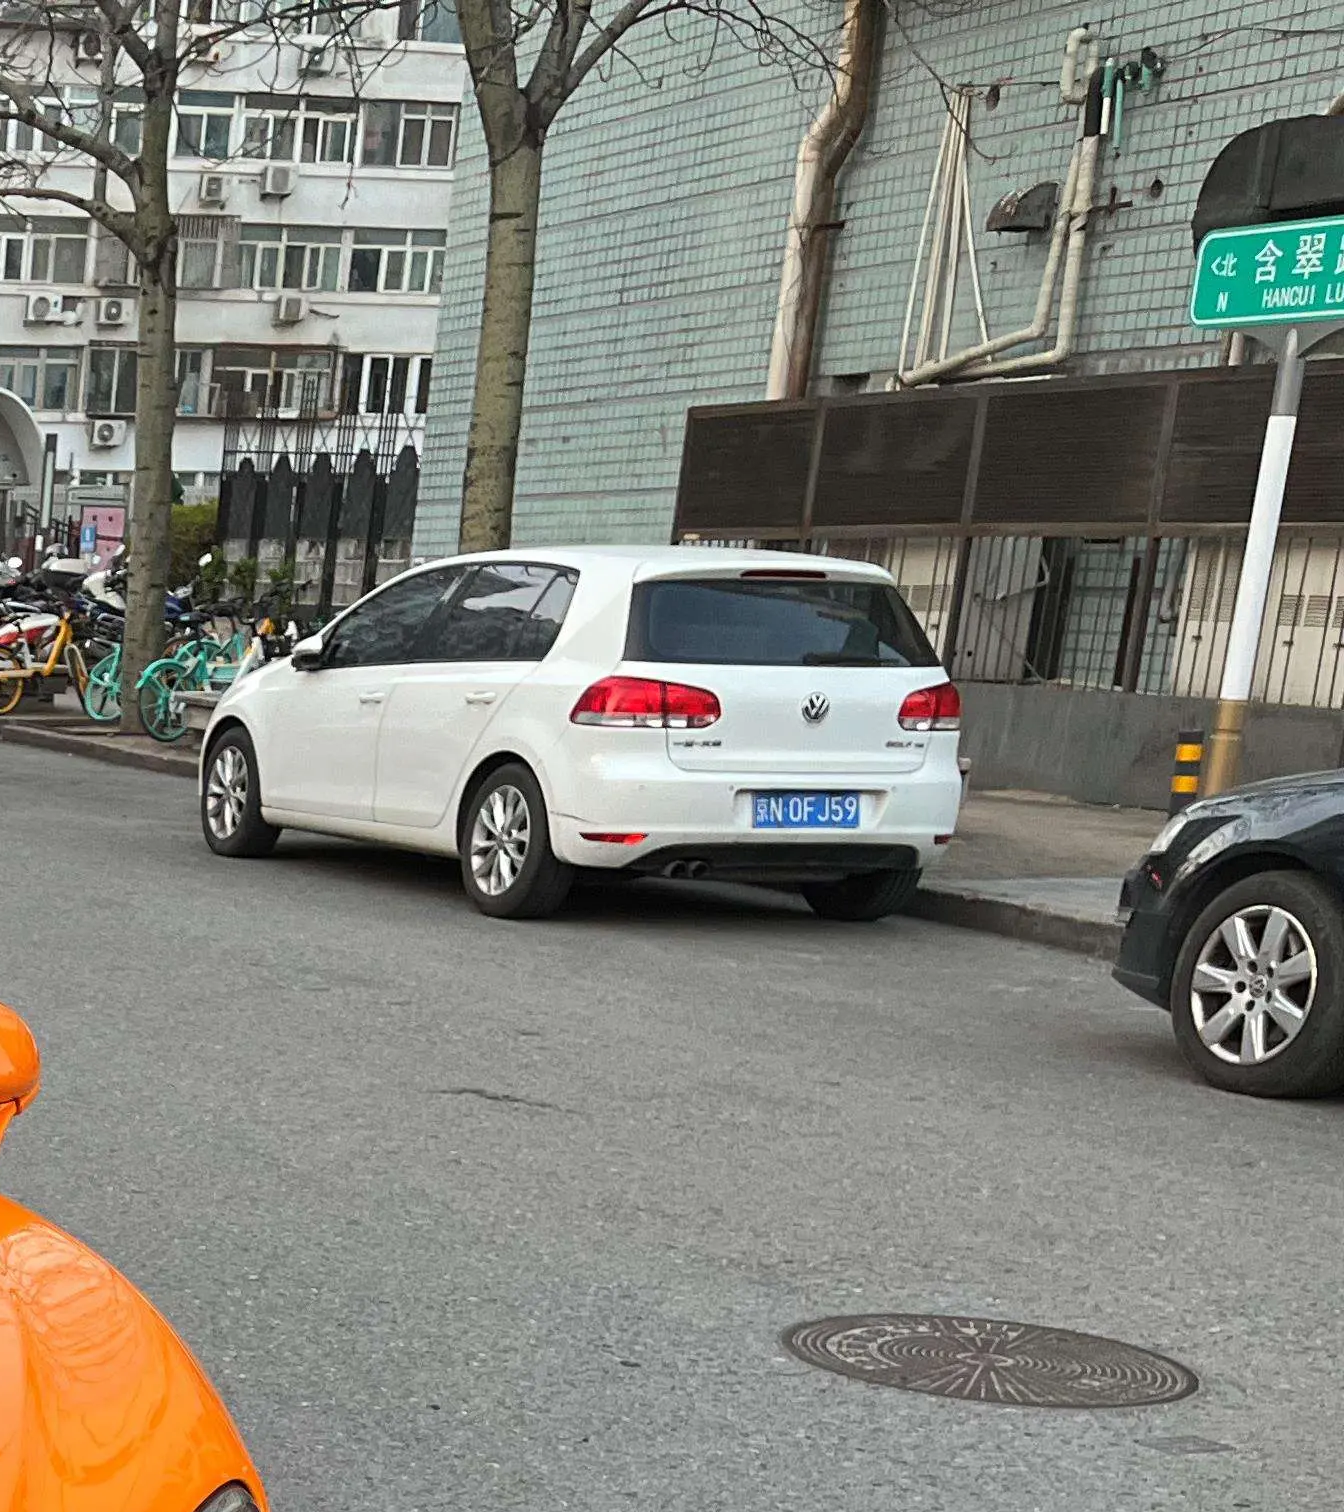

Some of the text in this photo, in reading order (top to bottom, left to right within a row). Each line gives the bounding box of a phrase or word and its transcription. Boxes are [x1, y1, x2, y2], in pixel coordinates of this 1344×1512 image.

[1220, 252, 1238, 277] 北
[1216, 291, 1229, 313] N
[1262, 281, 1344, 309] HANCUI LU
